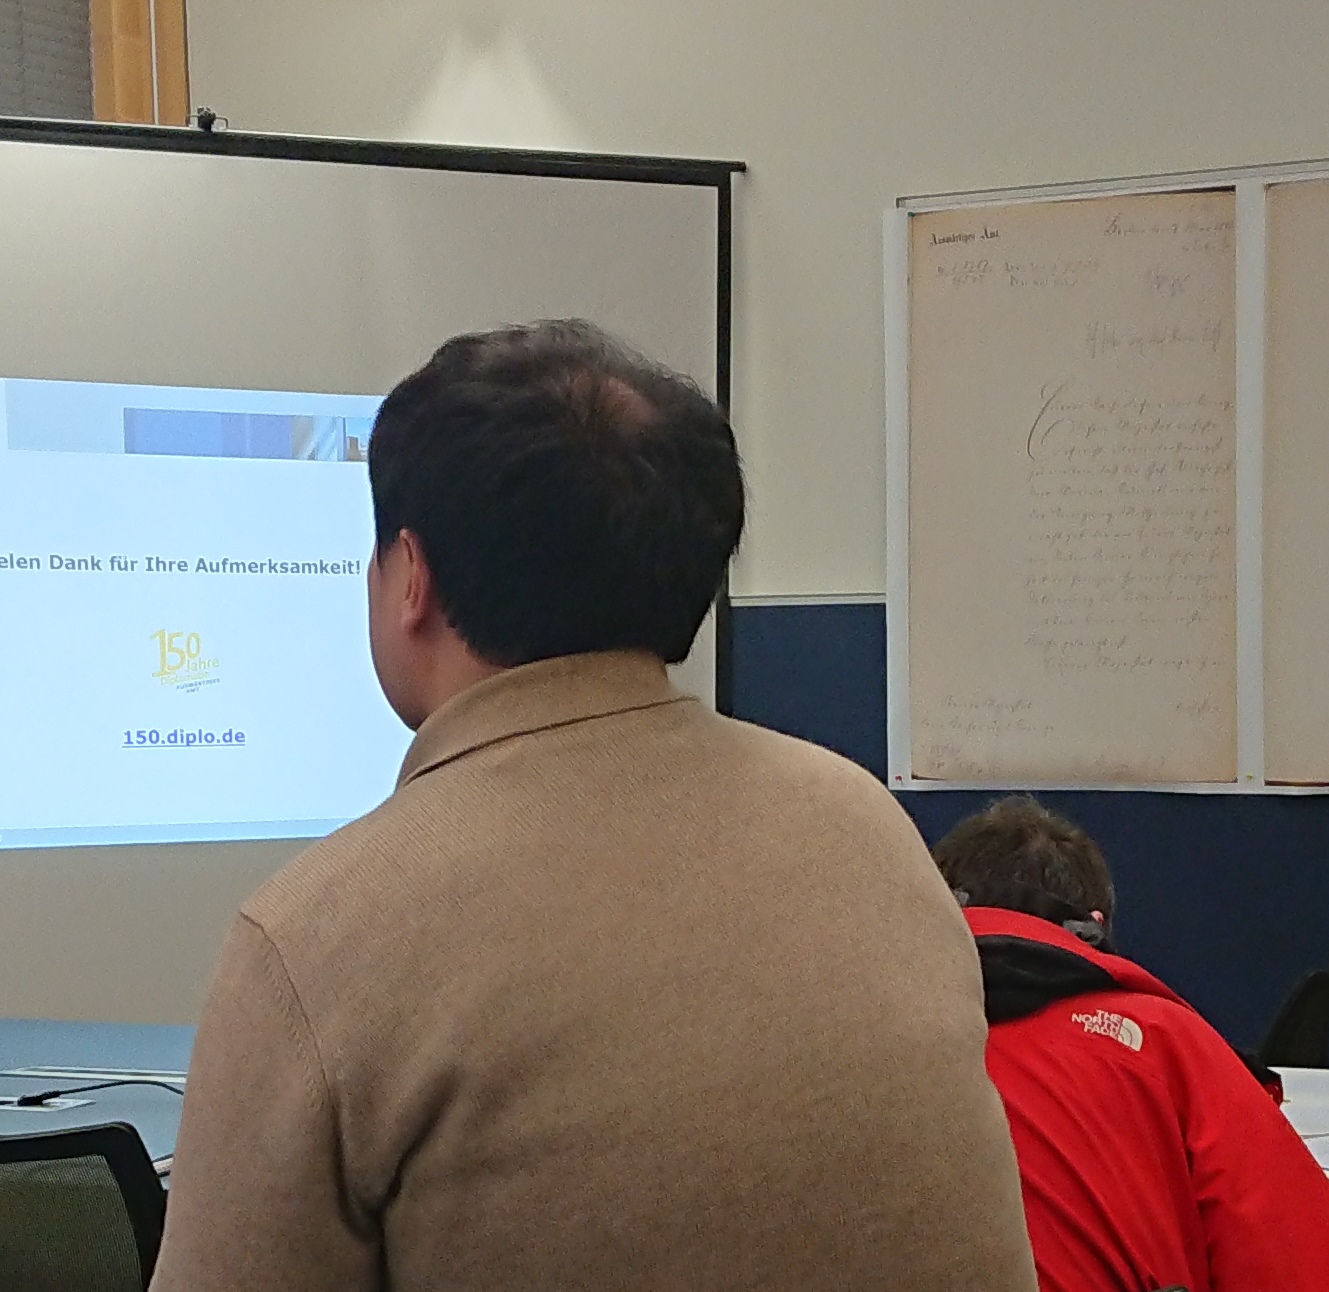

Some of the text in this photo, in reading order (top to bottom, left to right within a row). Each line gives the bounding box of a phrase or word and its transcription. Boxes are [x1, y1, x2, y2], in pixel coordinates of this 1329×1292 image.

[49, 554, 103, 571] Dank
[109, 555, 139, 572] für
[145, 556, 189, 573] Ihre
[195, 557, 361, 575] Aufmerksamkeit!
[150, 629, 201, 677] 150
[122, 728, 246, 748] 150.diplo.de
[1071, 1012, 1121, 1029] NORTH
[1096, 1009, 1122, 1022] THE
[1083, 1022, 1119, 1040] FACE
